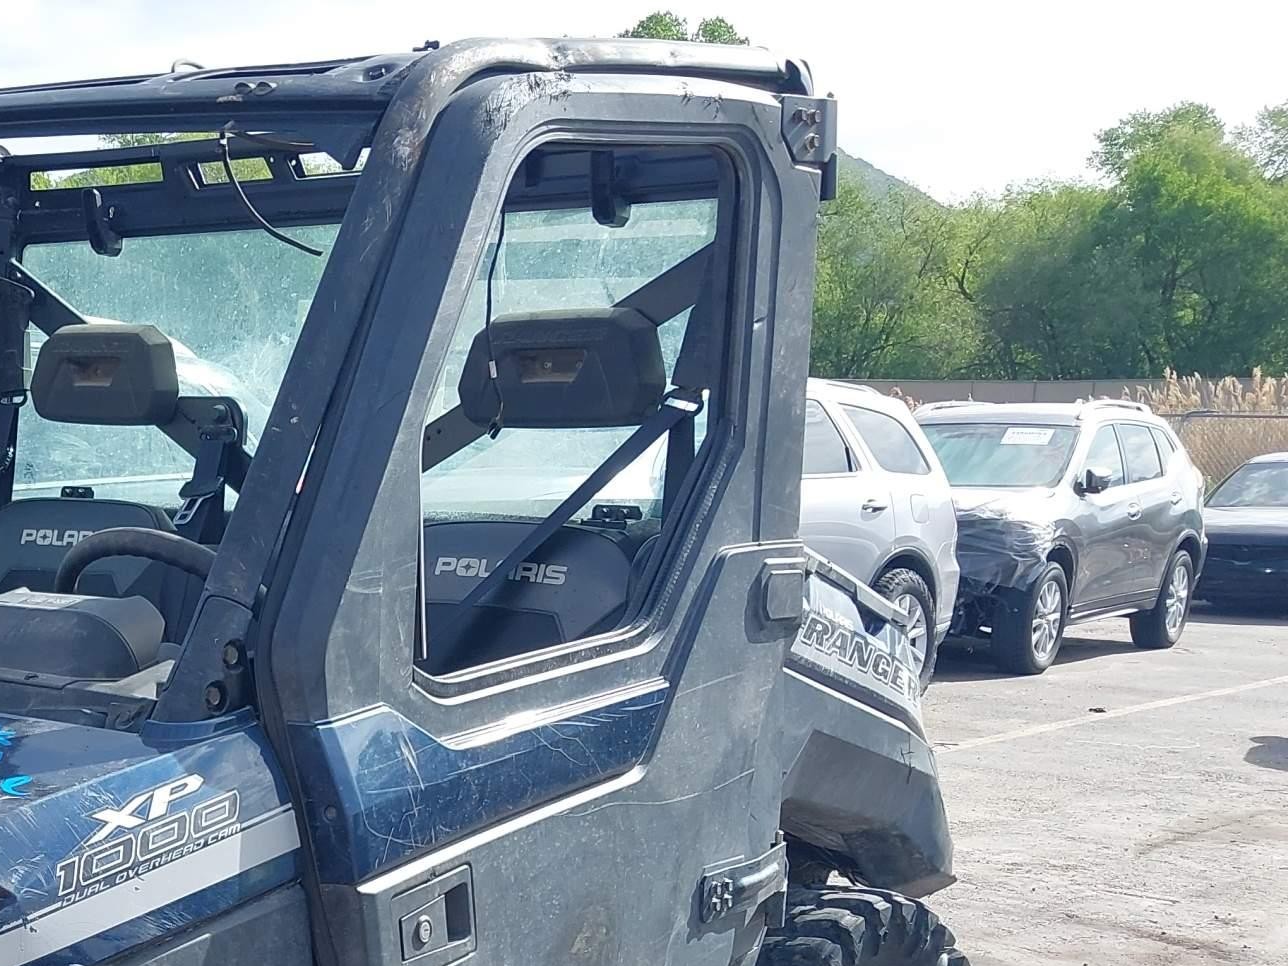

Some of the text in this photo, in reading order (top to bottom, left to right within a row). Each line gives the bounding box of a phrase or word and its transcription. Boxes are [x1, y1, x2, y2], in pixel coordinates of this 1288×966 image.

[800, 614, 920, 707] RANGER
[56, 788, 240, 897] 1000
[79, 772, 206, 848] XP
[61, 822, 241, 907] DUAL OVERHEAD CAM
